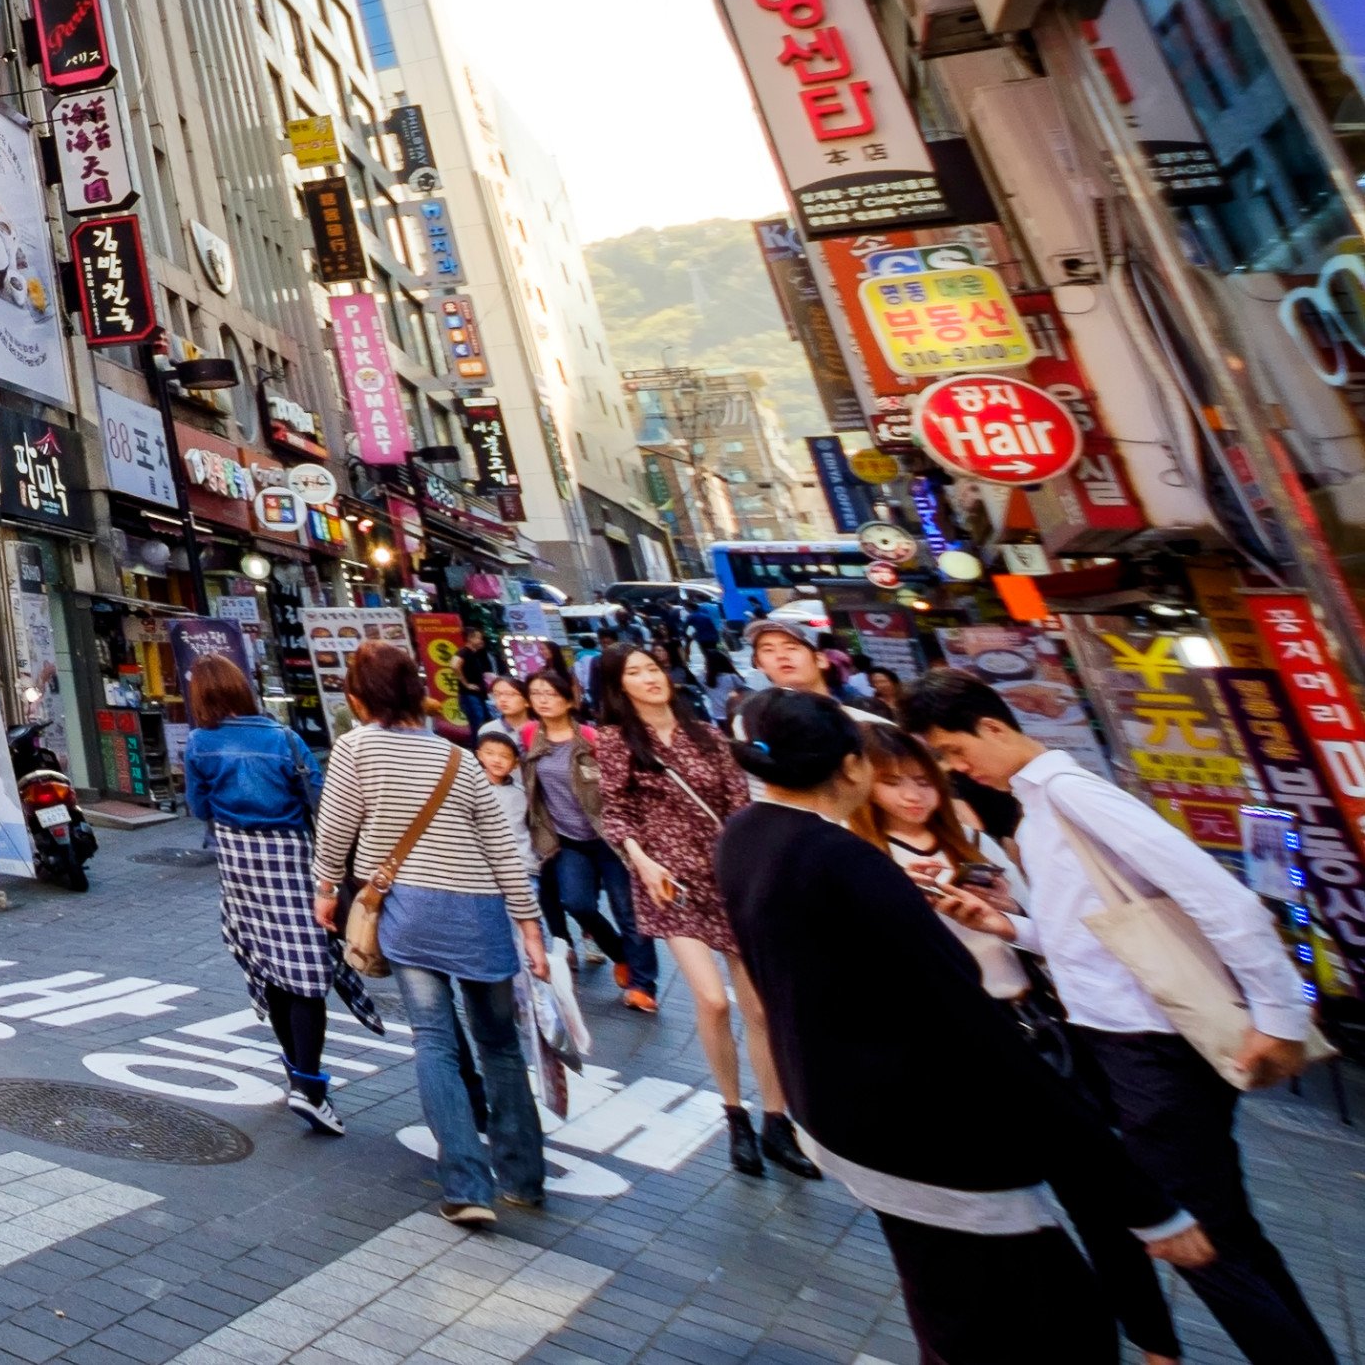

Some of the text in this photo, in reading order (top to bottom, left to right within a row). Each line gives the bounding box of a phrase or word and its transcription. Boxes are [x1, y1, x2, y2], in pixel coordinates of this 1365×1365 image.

[65, 49, 101, 67] パリス
[824, 143, 890, 167] 本店
[803, 189, 944, 215] ROAST CHICKEN
[93, 226, 134, 333] 김밥천국
[883, 298, 1014, 346] 부동산
[344, 304, 393, 456] PINK MART
[940, 414, 1057, 458] Hair
